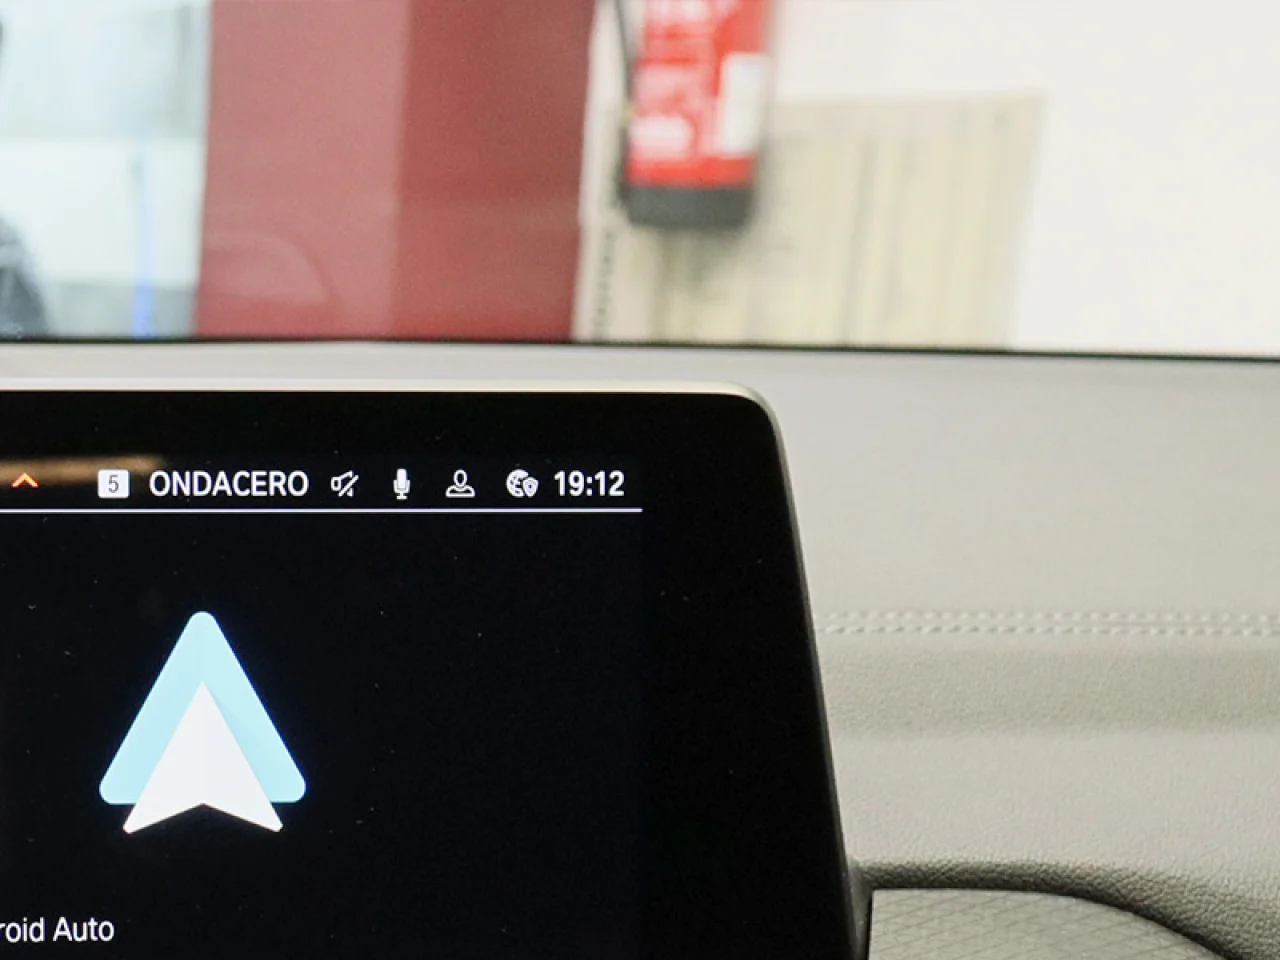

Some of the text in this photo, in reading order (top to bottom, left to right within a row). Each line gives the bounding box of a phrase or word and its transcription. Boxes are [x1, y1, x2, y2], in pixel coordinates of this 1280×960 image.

[108, 469, 310, 498] 5 ONDACERO
[554, 469, 625, 497] 19:12
[52, 916, 115, 943] Auto
